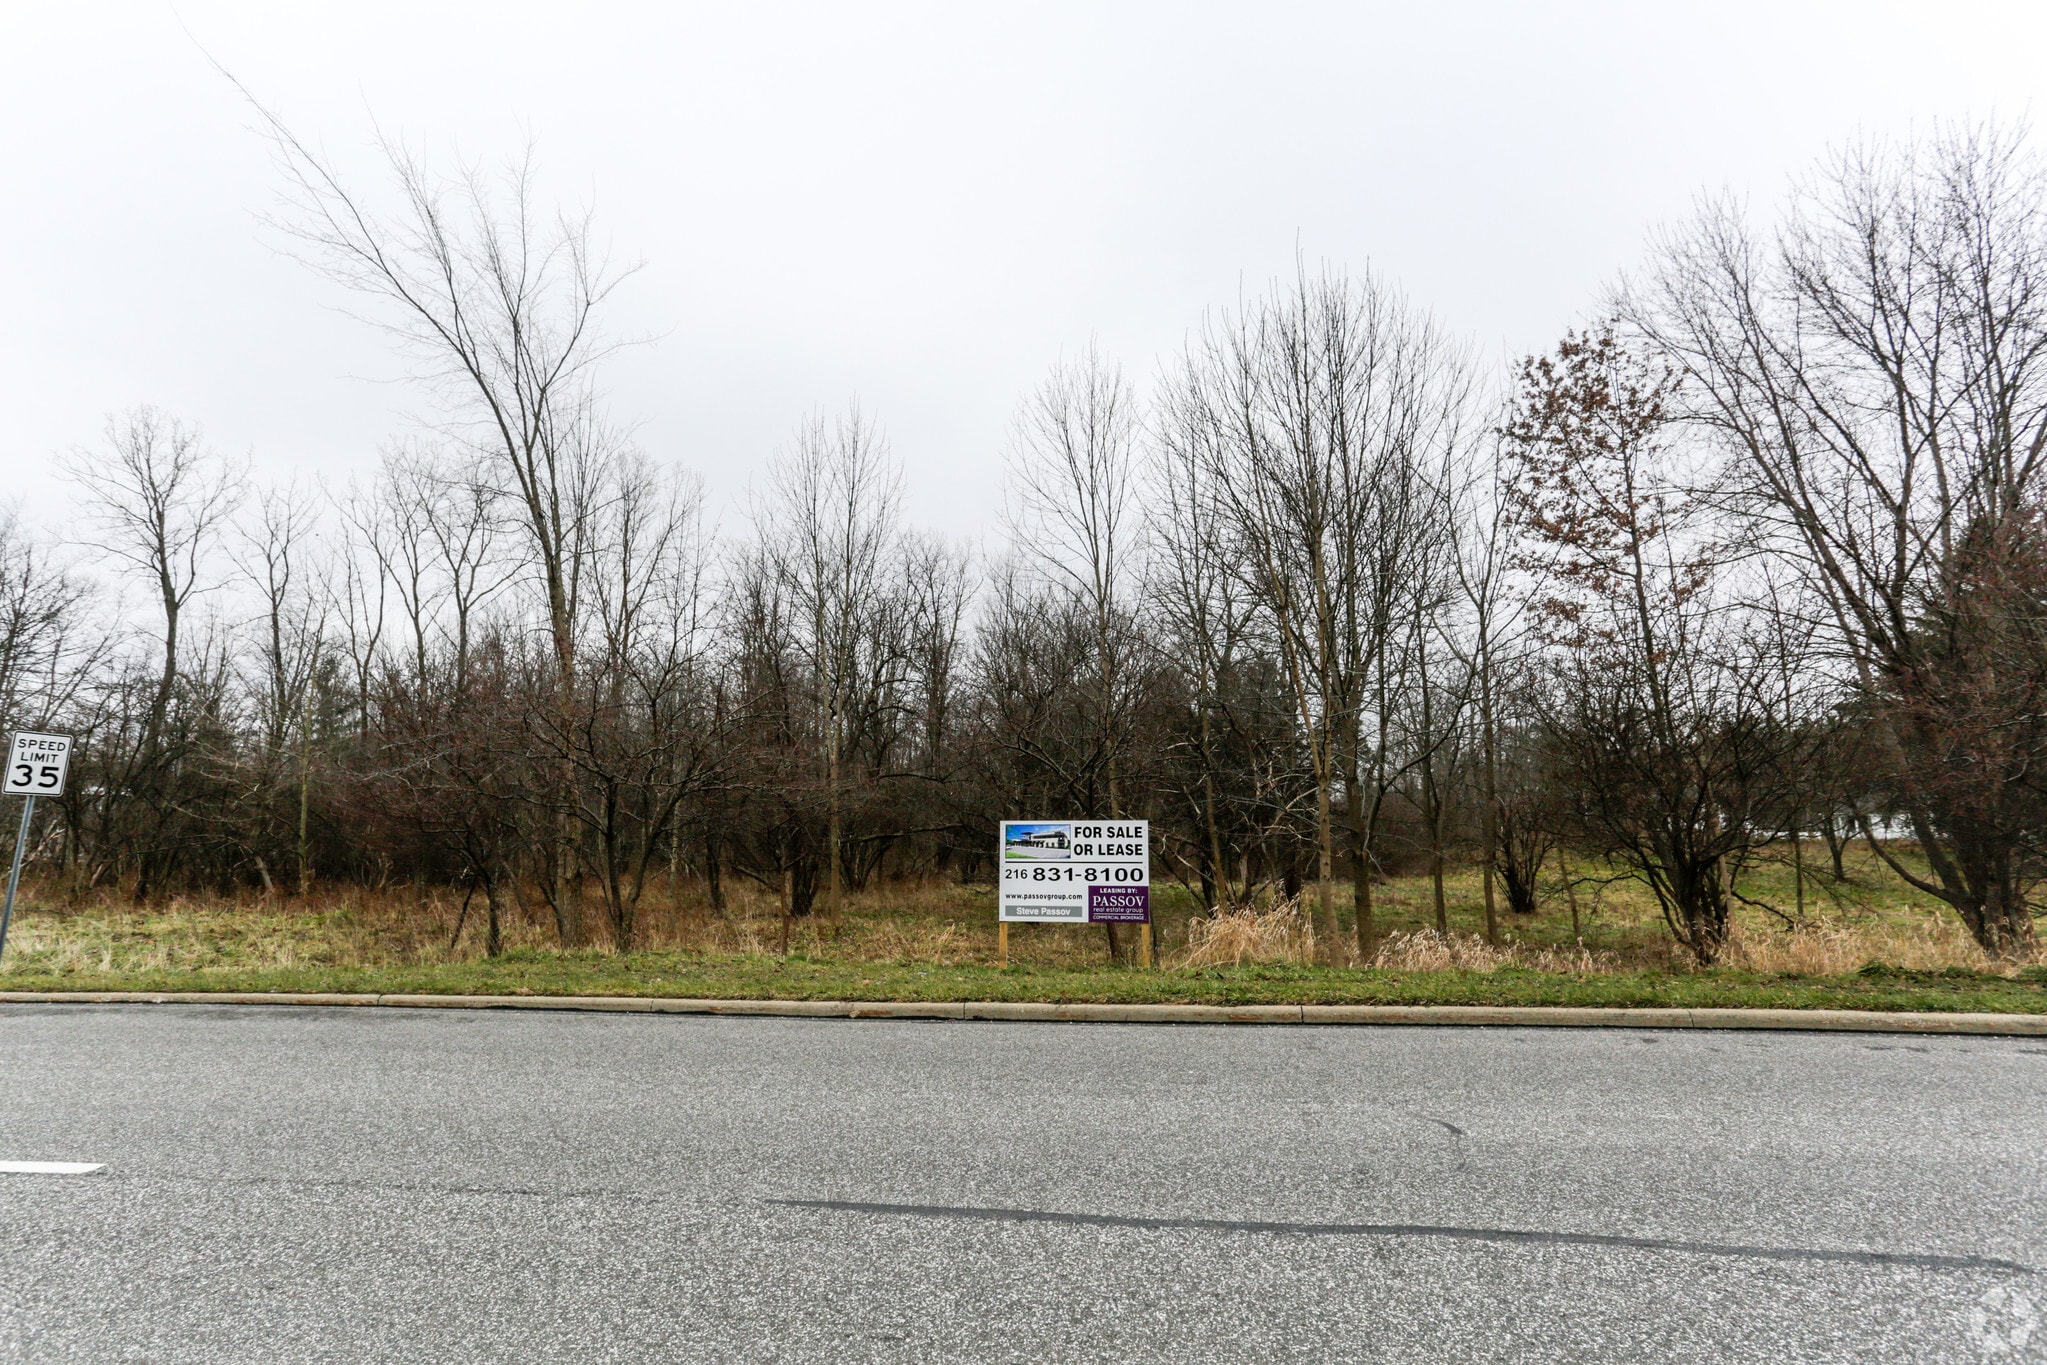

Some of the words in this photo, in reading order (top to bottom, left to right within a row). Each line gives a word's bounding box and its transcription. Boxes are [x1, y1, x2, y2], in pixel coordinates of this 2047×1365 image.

[18, 739, 66, 751] SPEED
[21, 752, 59, 763] LIMIT
[12, 764, 59, 788] 35
[1075, 826, 1102, 838] FOR
[1107, 826, 1142, 838] SALE
[1074, 844, 1093, 856] OR
[1098, 844, 1143, 856] LEASE
[1005, 869, 1027, 879] 216
[1033, 868, 1143, 881] 831-8100
[1093, 896, 1144, 906] PASSOV
[1041, 908, 1070, 916] Passov
